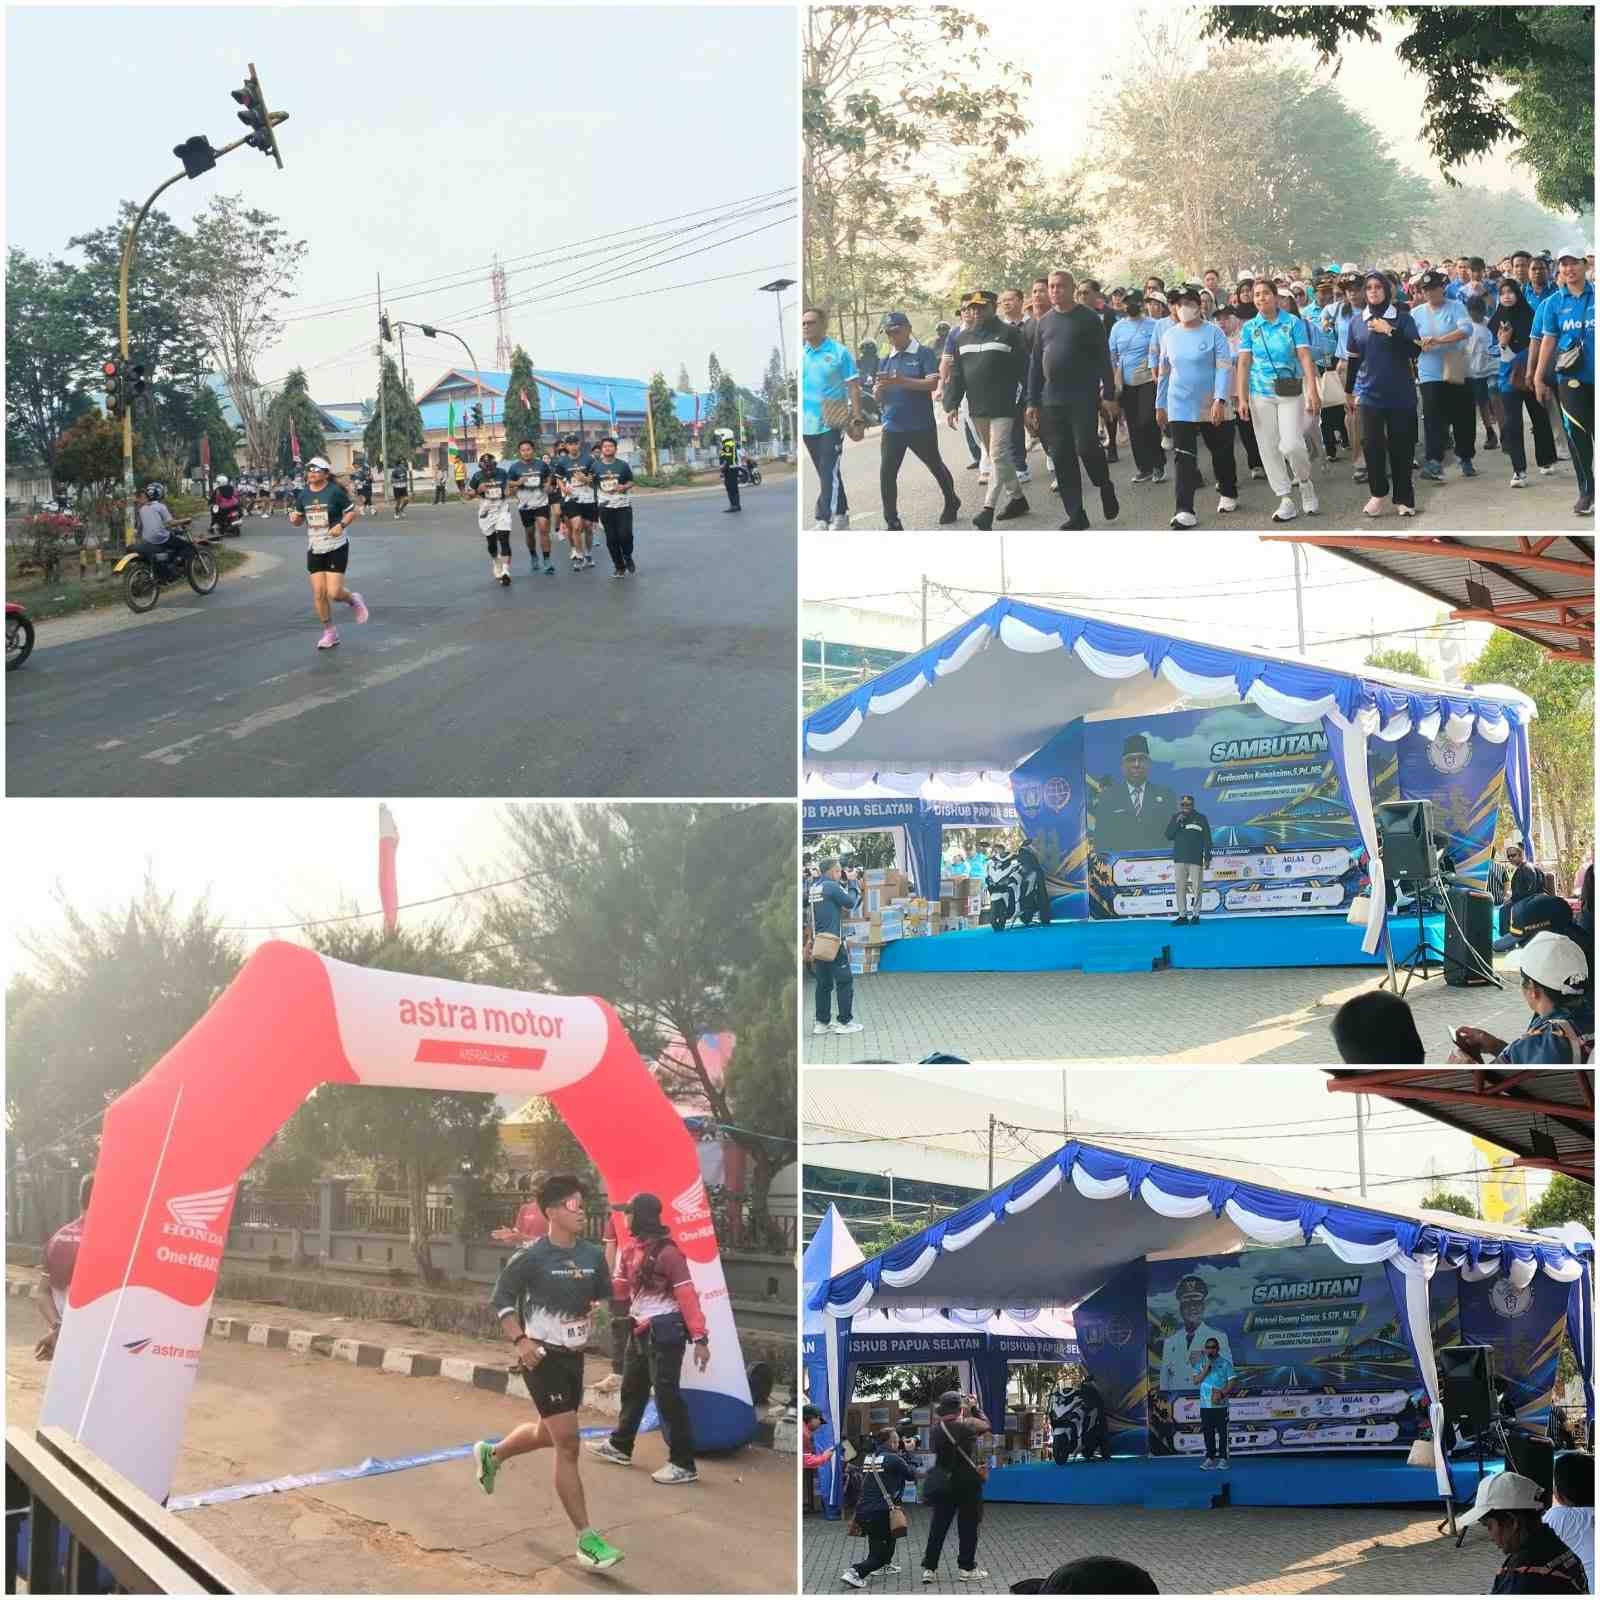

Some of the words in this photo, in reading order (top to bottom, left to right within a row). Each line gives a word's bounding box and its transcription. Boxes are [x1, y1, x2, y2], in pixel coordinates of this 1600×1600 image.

[1211, 733, 1328, 762] SAMBUTAN
[820, 806, 861, 817] PAPUA
[863, 803, 913, 816] SELATAN
[934, 805, 972, 816] DISHUB
[973, 807, 1001, 817] PAPUA
[399, 996, 477, 1030] astra
[483, 1007, 563, 1039] motor
[156, 1246, 187, 1264] One
[1253, 1278, 1360, 1301] SAMBUTAN
[891, 1338, 929, 1351] PAPUA
[932, 1338, 980, 1350] SELATAN
[1000, 1341, 1036, 1352] DISHUB
